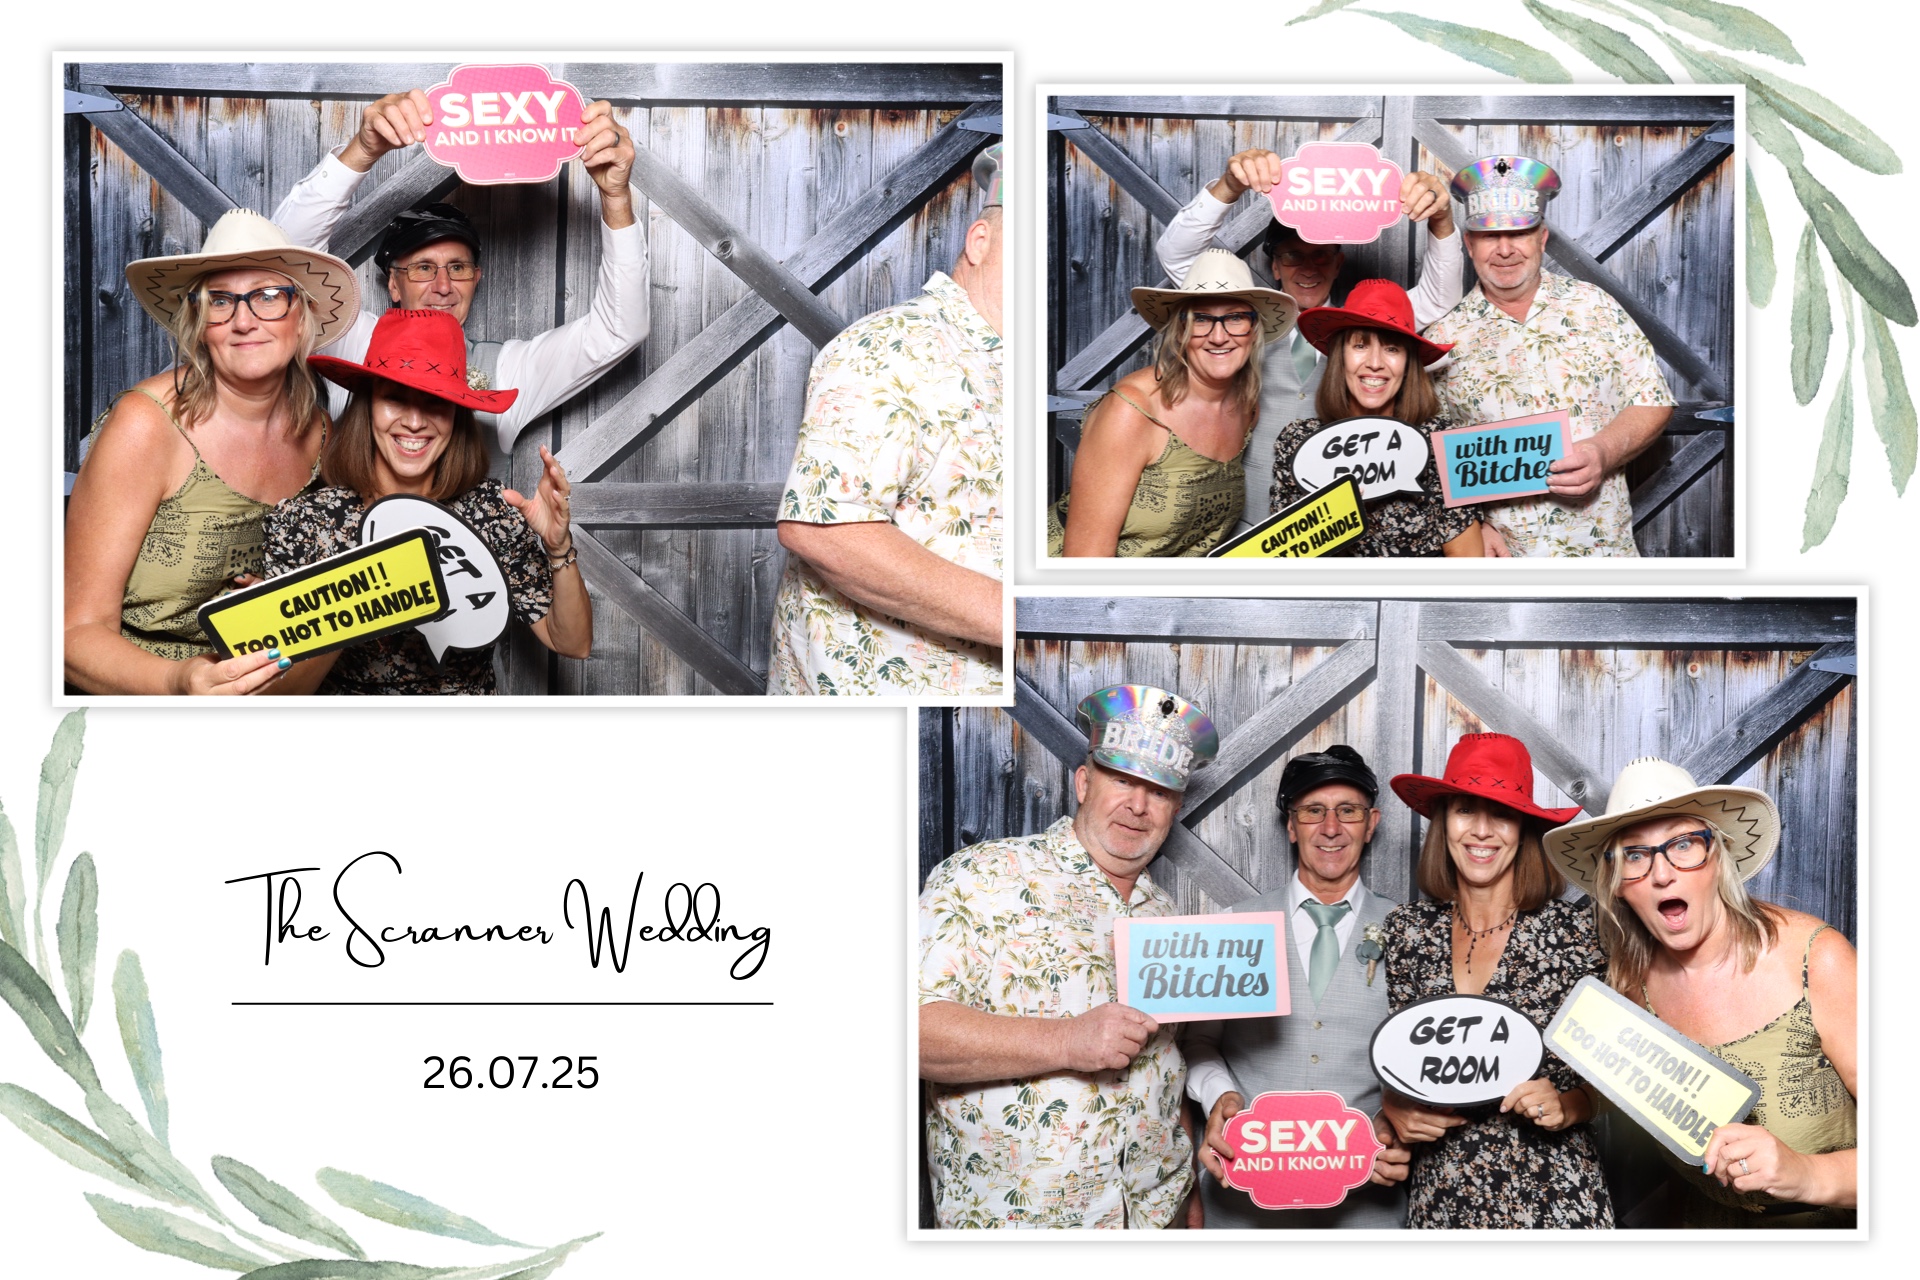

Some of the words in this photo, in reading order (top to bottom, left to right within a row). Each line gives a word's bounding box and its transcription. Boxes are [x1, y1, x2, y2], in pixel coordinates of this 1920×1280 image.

[439, 90, 567, 127] SEXY
[434, 130, 479, 146] AND
[484, 130, 490, 145] I
[495, 127, 557, 144] KNOW
[561, 127, 577, 142] IT
[1287, 167, 1392, 197] SEXY
[1281, 199, 1318, 212] AND
[1321, 199, 1327, 212] I
[1329, 199, 1382, 212] KNOW
[1383, 198, 1398, 212] IT
[1468, 187, 1539, 215] BRIDE
[1322, 431, 1380, 459] GET
[1386, 429, 1402, 451] A
[1455, 434, 1508, 459] with
[1513, 434, 1552, 456] my
[1261, 502, 1333, 554] CAUTION!!
[1289, 541, 1310, 558] TO
[1309, 511, 1361, 550] HANDLE
[280, 562, 391, 618] CAUTION!!
[465, 591, 497, 610] A
[232, 634, 279, 656] TOO
[279, 617, 321, 646] HOT
[323, 610, 354, 632] TO
[354, 580, 436, 624] HANDLE
[1102, 721, 1194, 777] BRIDE
[1142, 931, 1209, 960] with
[1217, 938, 1264, 967] my
[1138, 962, 1270, 1000] Bitches
[1409, 1015, 1483, 1046] GET
[1489, 1015, 1510, 1044] A
[1419, 1055, 1500, 1085] ROOM
[1616, 1027, 1711, 1099] CAUTION!!
[1562, 1017, 1596, 1050] TOO
[1591, 1041, 1632, 1076] HOT
[1625, 1065, 1651, 1094] TO
[1645, 1083, 1718, 1148] HANDLE
[1240, 1119, 1358, 1154] SEXY
[1232, 1157, 1274, 1172] AND
[1278, 1157, 1284, 1171] I
[1288, 1156, 1347, 1171] KNOW
[1350, 1155, 1366, 1169] IT
